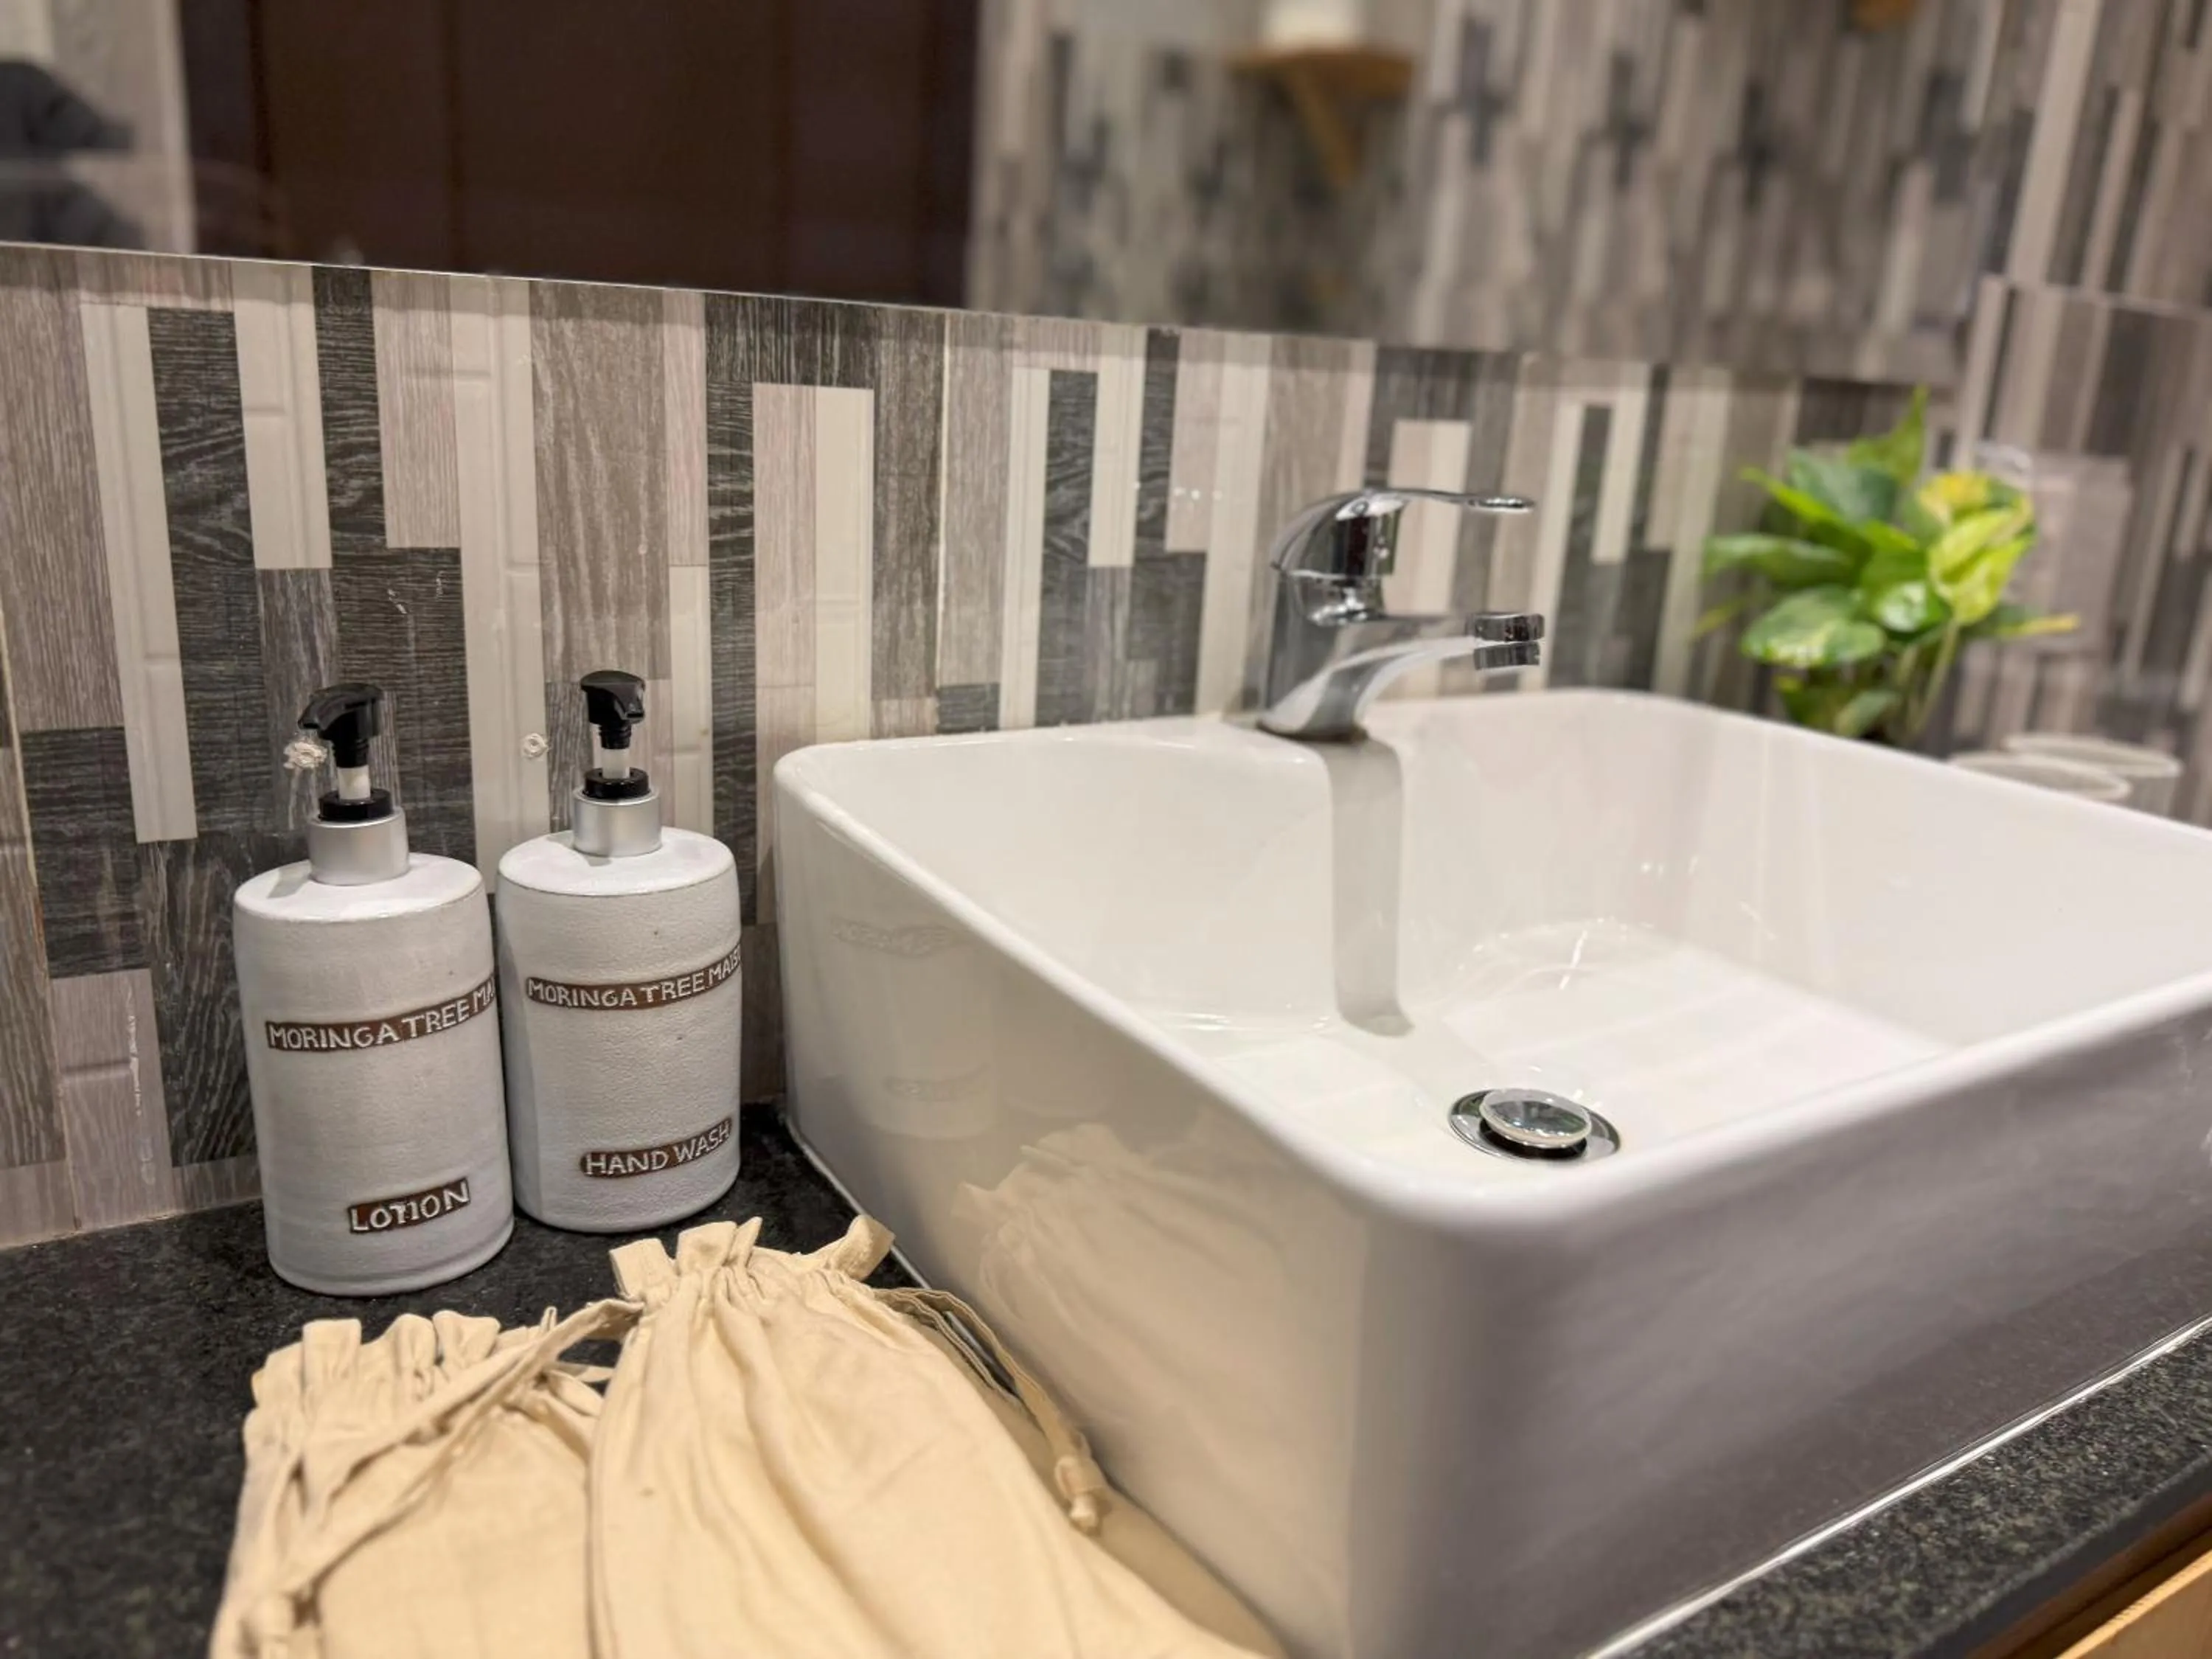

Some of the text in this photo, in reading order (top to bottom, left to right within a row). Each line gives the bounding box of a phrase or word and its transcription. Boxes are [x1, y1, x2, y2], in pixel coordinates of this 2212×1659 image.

[527, 978, 639, 1007] MORINGA
[640, 973, 706, 1004] TREE
[268, 1023, 400, 1049] MORINGA
[400, 998, 470, 1038] TREE
[585, 1121, 730, 1175] HAND WASH
[351, 1181, 470, 1231] LOTION
